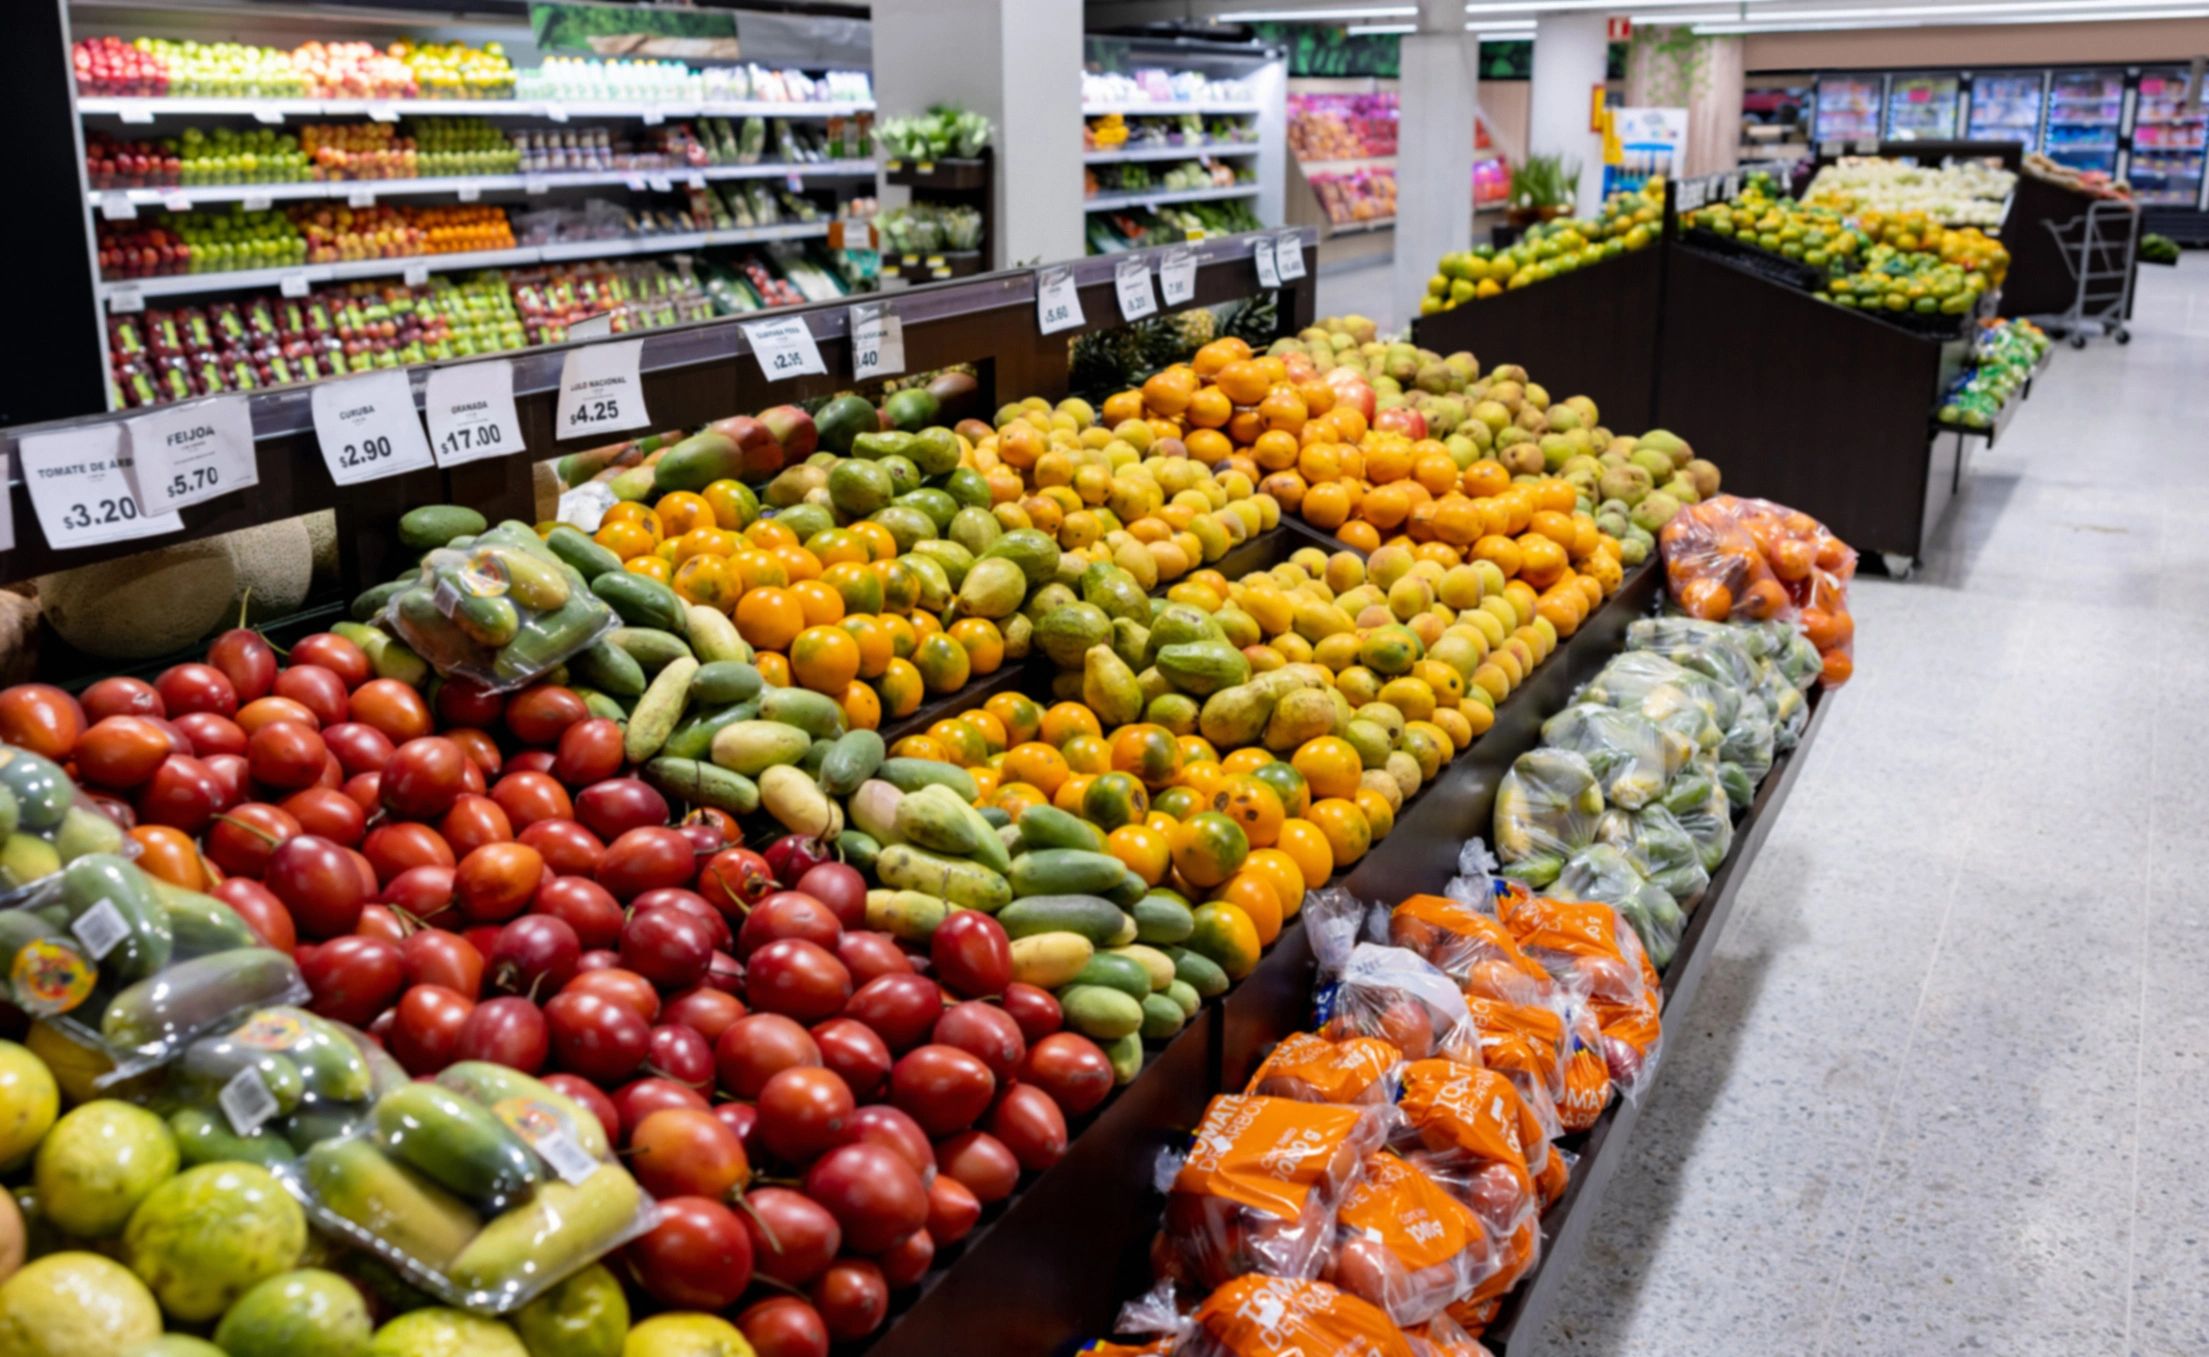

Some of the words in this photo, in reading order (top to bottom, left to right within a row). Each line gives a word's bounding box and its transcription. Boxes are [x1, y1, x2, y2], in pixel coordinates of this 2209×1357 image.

[589, 376, 627, 388] NACIONAL
[339, 405, 376, 420] CURUBA
[450, 401, 488, 415] GRANADA
[570, 400, 620, 425] $4.25
[166, 425, 216, 446] FEIJOA
[441, 423, 502, 455] $17.00
[339, 435, 392, 468] $2.90
[38, 464, 87, 479] TOMATE
[90, 461, 106, 472] DE
[167, 466, 219, 498] $5.70
[63, 496, 137, 530] $3.20
